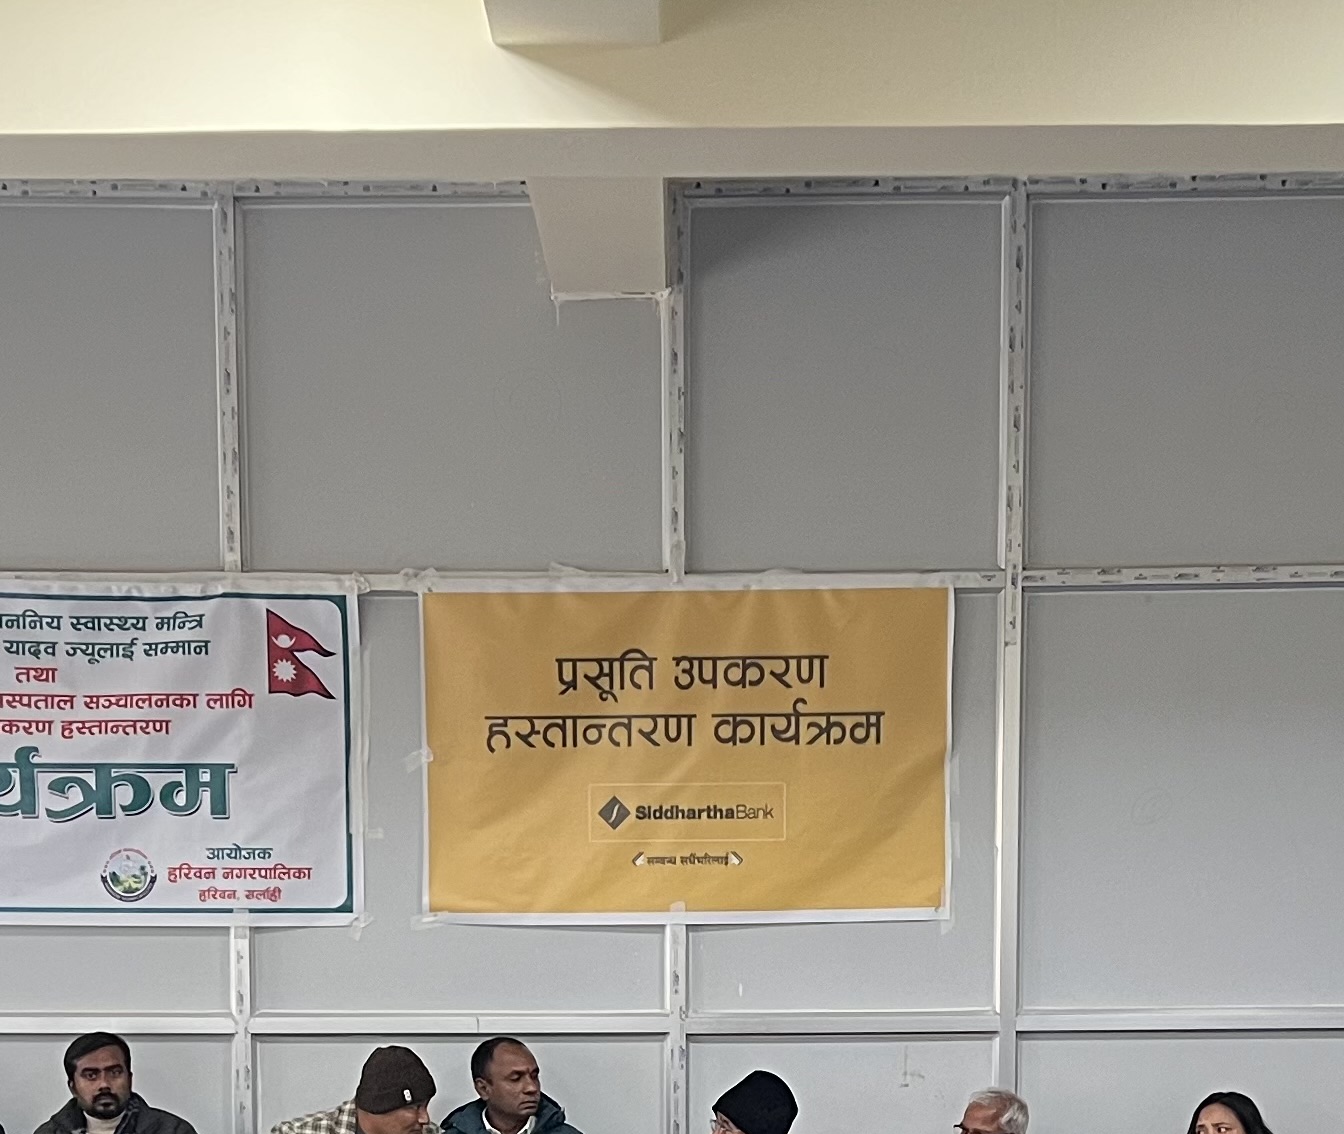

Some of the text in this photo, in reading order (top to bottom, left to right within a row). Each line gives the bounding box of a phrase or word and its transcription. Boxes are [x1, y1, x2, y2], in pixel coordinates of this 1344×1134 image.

[68, 614, 149, 632] स्वास्थ्य
[154, 611, 206, 631] मन्त्रि
[3, 640, 59, 660] यादव
[63, 637, 138, 665] ज्यूलाई
[142, 639, 212, 657] सम्मान
[13, 666, 58, 684] तथा
[555, 648, 830, 704] प्रसूति उपकरण
[83, 692, 200, 710] सञ्चालनका
[204, 687, 255, 710] लागि
[59, 718, 172, 741] हस्तान्तरण
[484, 697, 886, 754] हस्तान्तरण कार्यक्रम
[206, 843, 273, 861] आयोजक
[168, 863, 313, 883] हरिवन नगरपालिका
[245, 886, 283, 902] सर्लाही
